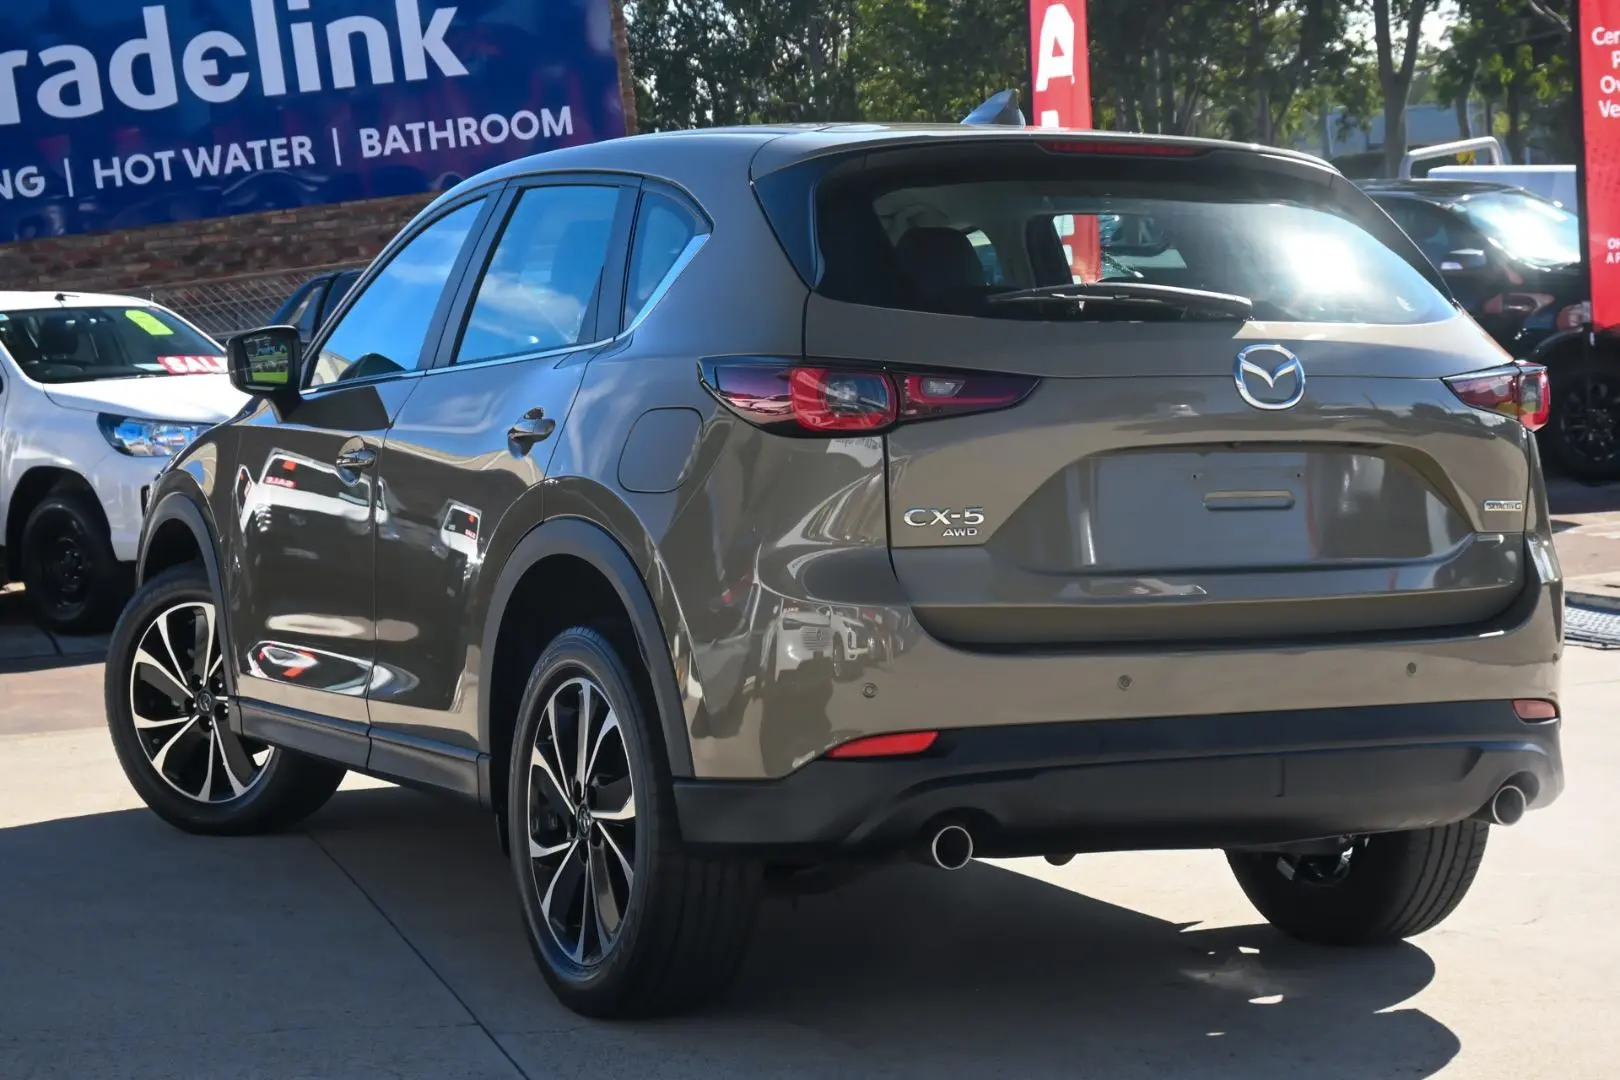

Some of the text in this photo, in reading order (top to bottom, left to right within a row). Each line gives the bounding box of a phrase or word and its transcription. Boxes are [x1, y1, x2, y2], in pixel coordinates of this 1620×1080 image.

[92, 149, 176, 189] HOT
[182, 135, 316, 178] WATER
[359, 106, 574, 158] BATHROOM
[903, 506, 985, 526] CX-5
[942, 527, 978, 537] AWD
